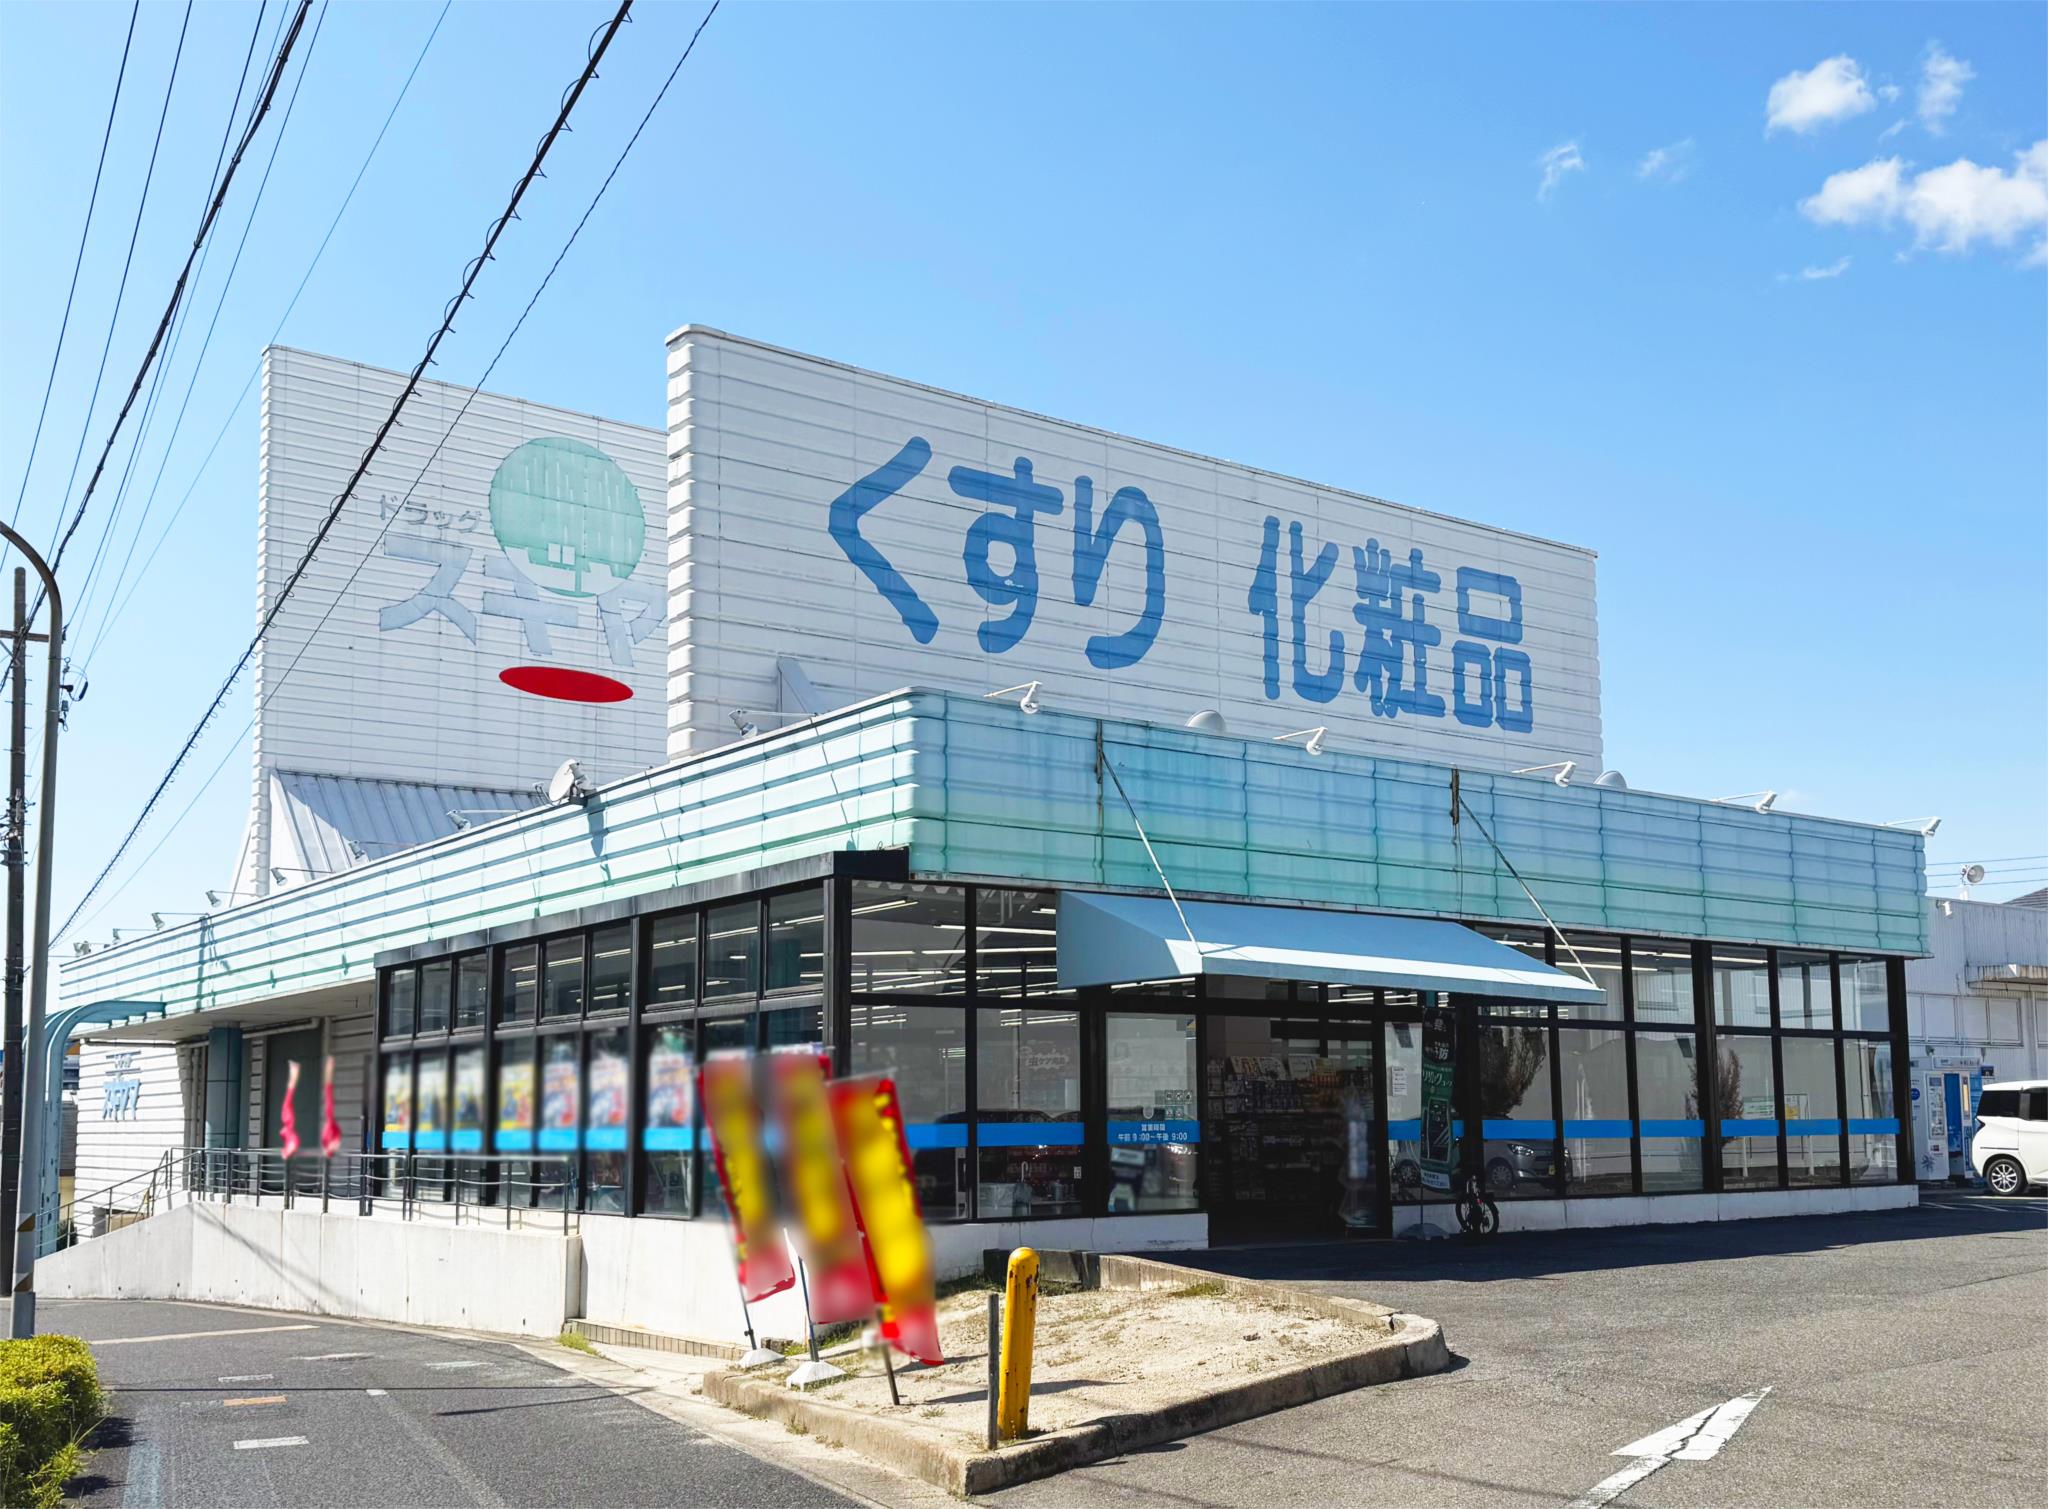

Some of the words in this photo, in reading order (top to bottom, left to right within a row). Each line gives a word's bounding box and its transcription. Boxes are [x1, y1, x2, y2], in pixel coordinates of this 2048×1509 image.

[380, 494, 483, 534] ドラッグ
[829, 436, 1165, 670] くすり
[1248, 515, 1533, 733] 化粧品
